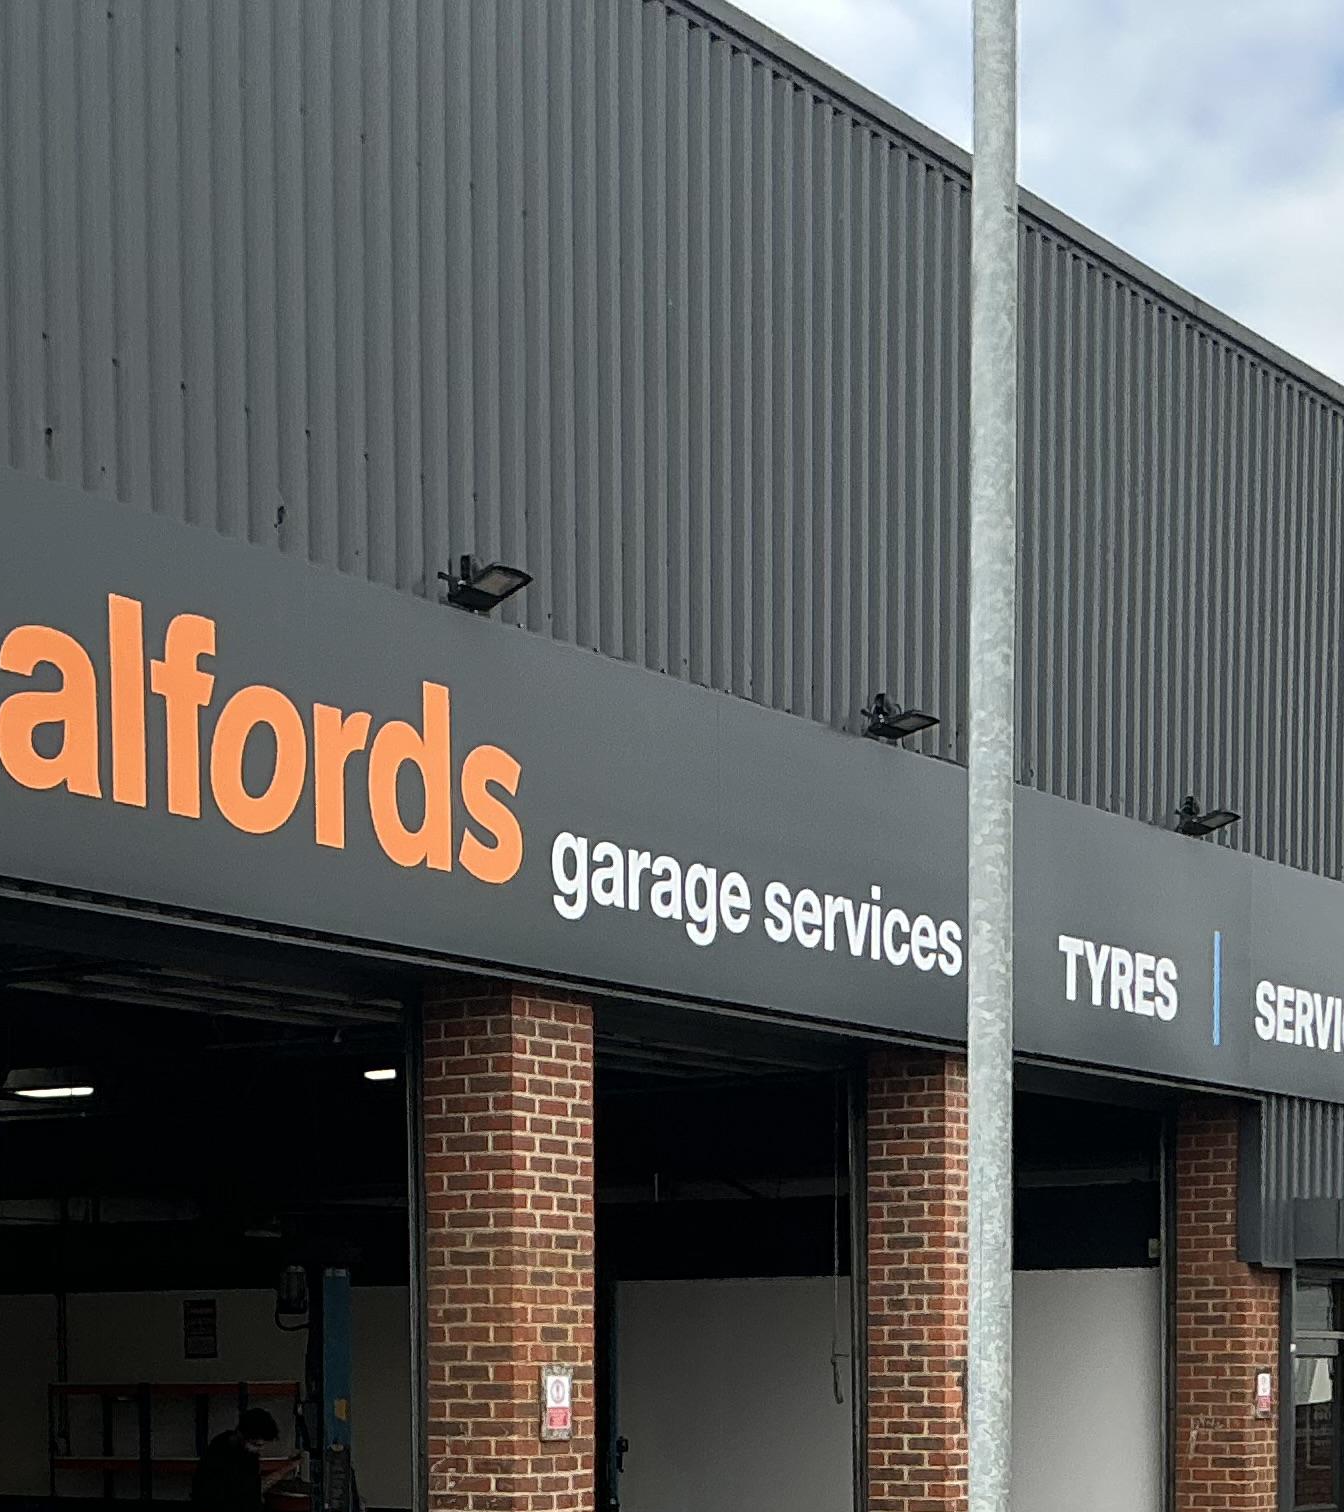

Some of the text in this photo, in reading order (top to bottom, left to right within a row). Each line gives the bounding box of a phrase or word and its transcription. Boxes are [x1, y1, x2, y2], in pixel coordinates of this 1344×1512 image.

[551, 831, 963, 976] garage services
[1058, 934, 1178, 1022] TYRES
